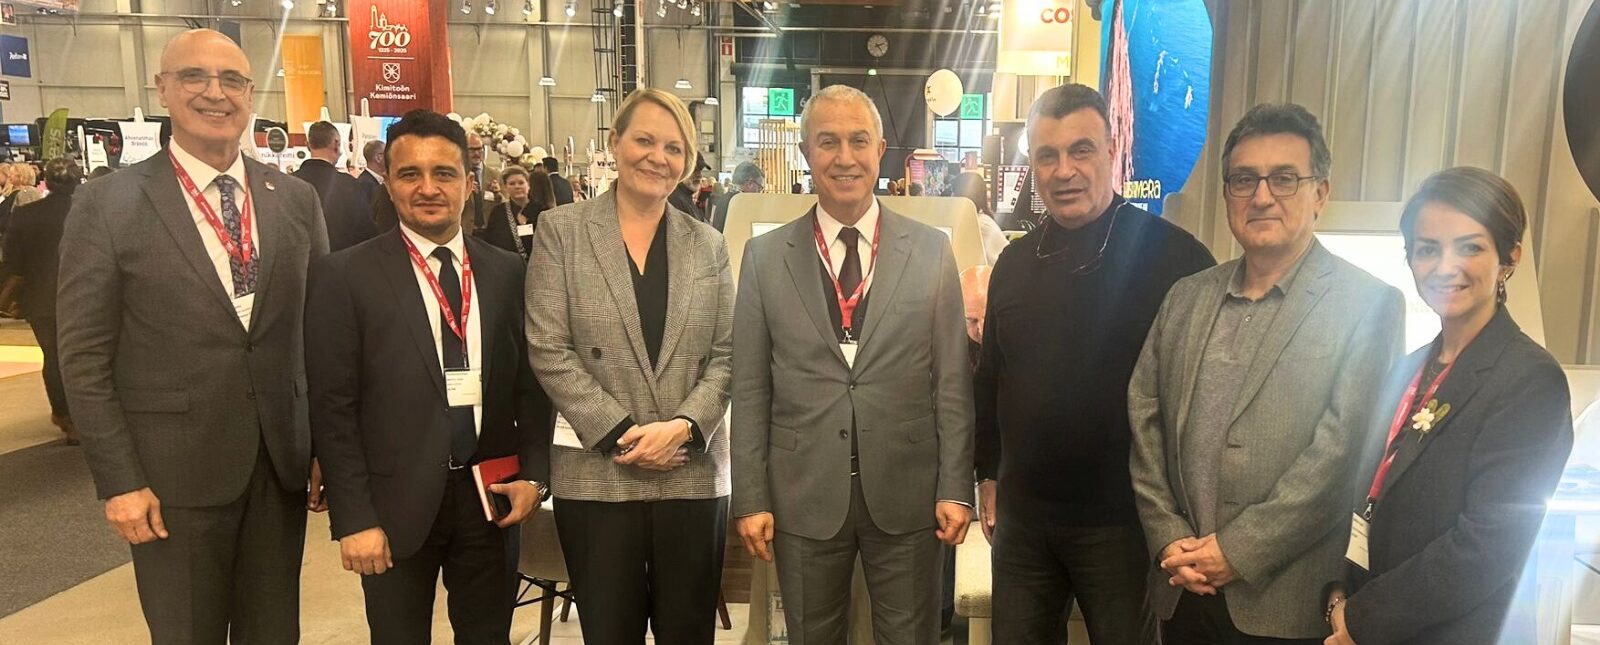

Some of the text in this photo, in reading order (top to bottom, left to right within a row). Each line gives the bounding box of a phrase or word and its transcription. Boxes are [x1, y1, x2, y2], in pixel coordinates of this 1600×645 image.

[1041, 8, 1073, 23] CO
[369, 31, 411, 50] 700
[375, 84, 410, 92] Kimitoön
[370, 92, 416, 100] Kemiönsaari
